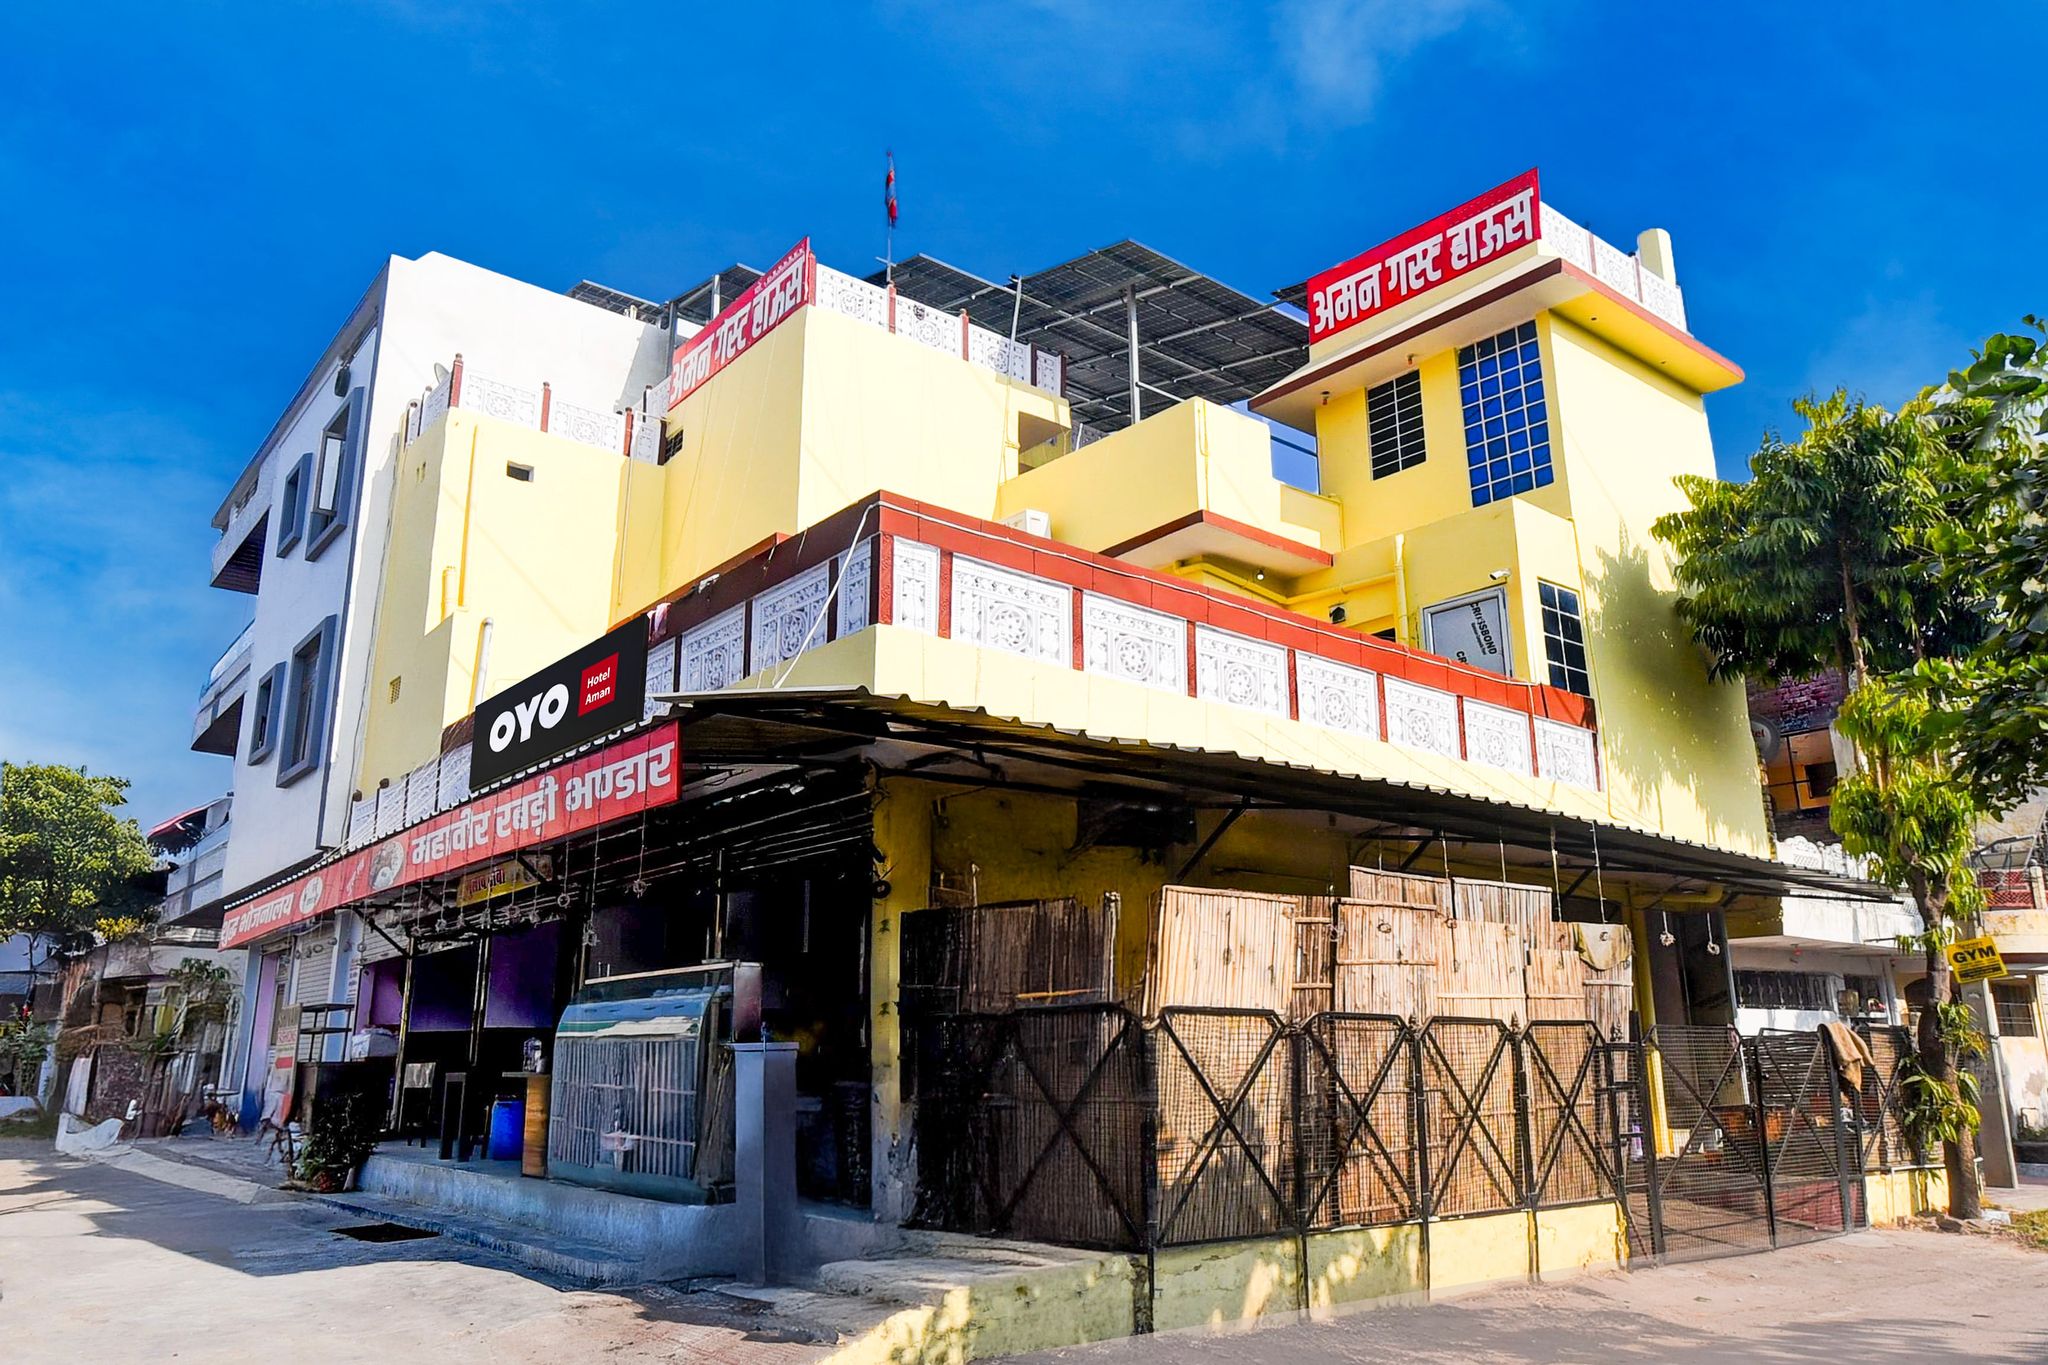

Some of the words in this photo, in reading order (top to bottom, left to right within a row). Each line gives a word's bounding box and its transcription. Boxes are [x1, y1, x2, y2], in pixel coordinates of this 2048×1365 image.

[1313, 262, 1382, 334] अमन
[670, 335, 715, 402] अमन
[585, 686, 611, 706] Aman
[586, 667, 611, 689] Hotel
[489, 683, 569, 753] OYO
[411, 807, 491, 865] महावीर
[494, 777, 559, 838] रबड़ी
[565, 741, 675, 812] भण्डार
[239, 892, 295, 933] भोजनालय
[1953, 945, 1996, 963] GYM
